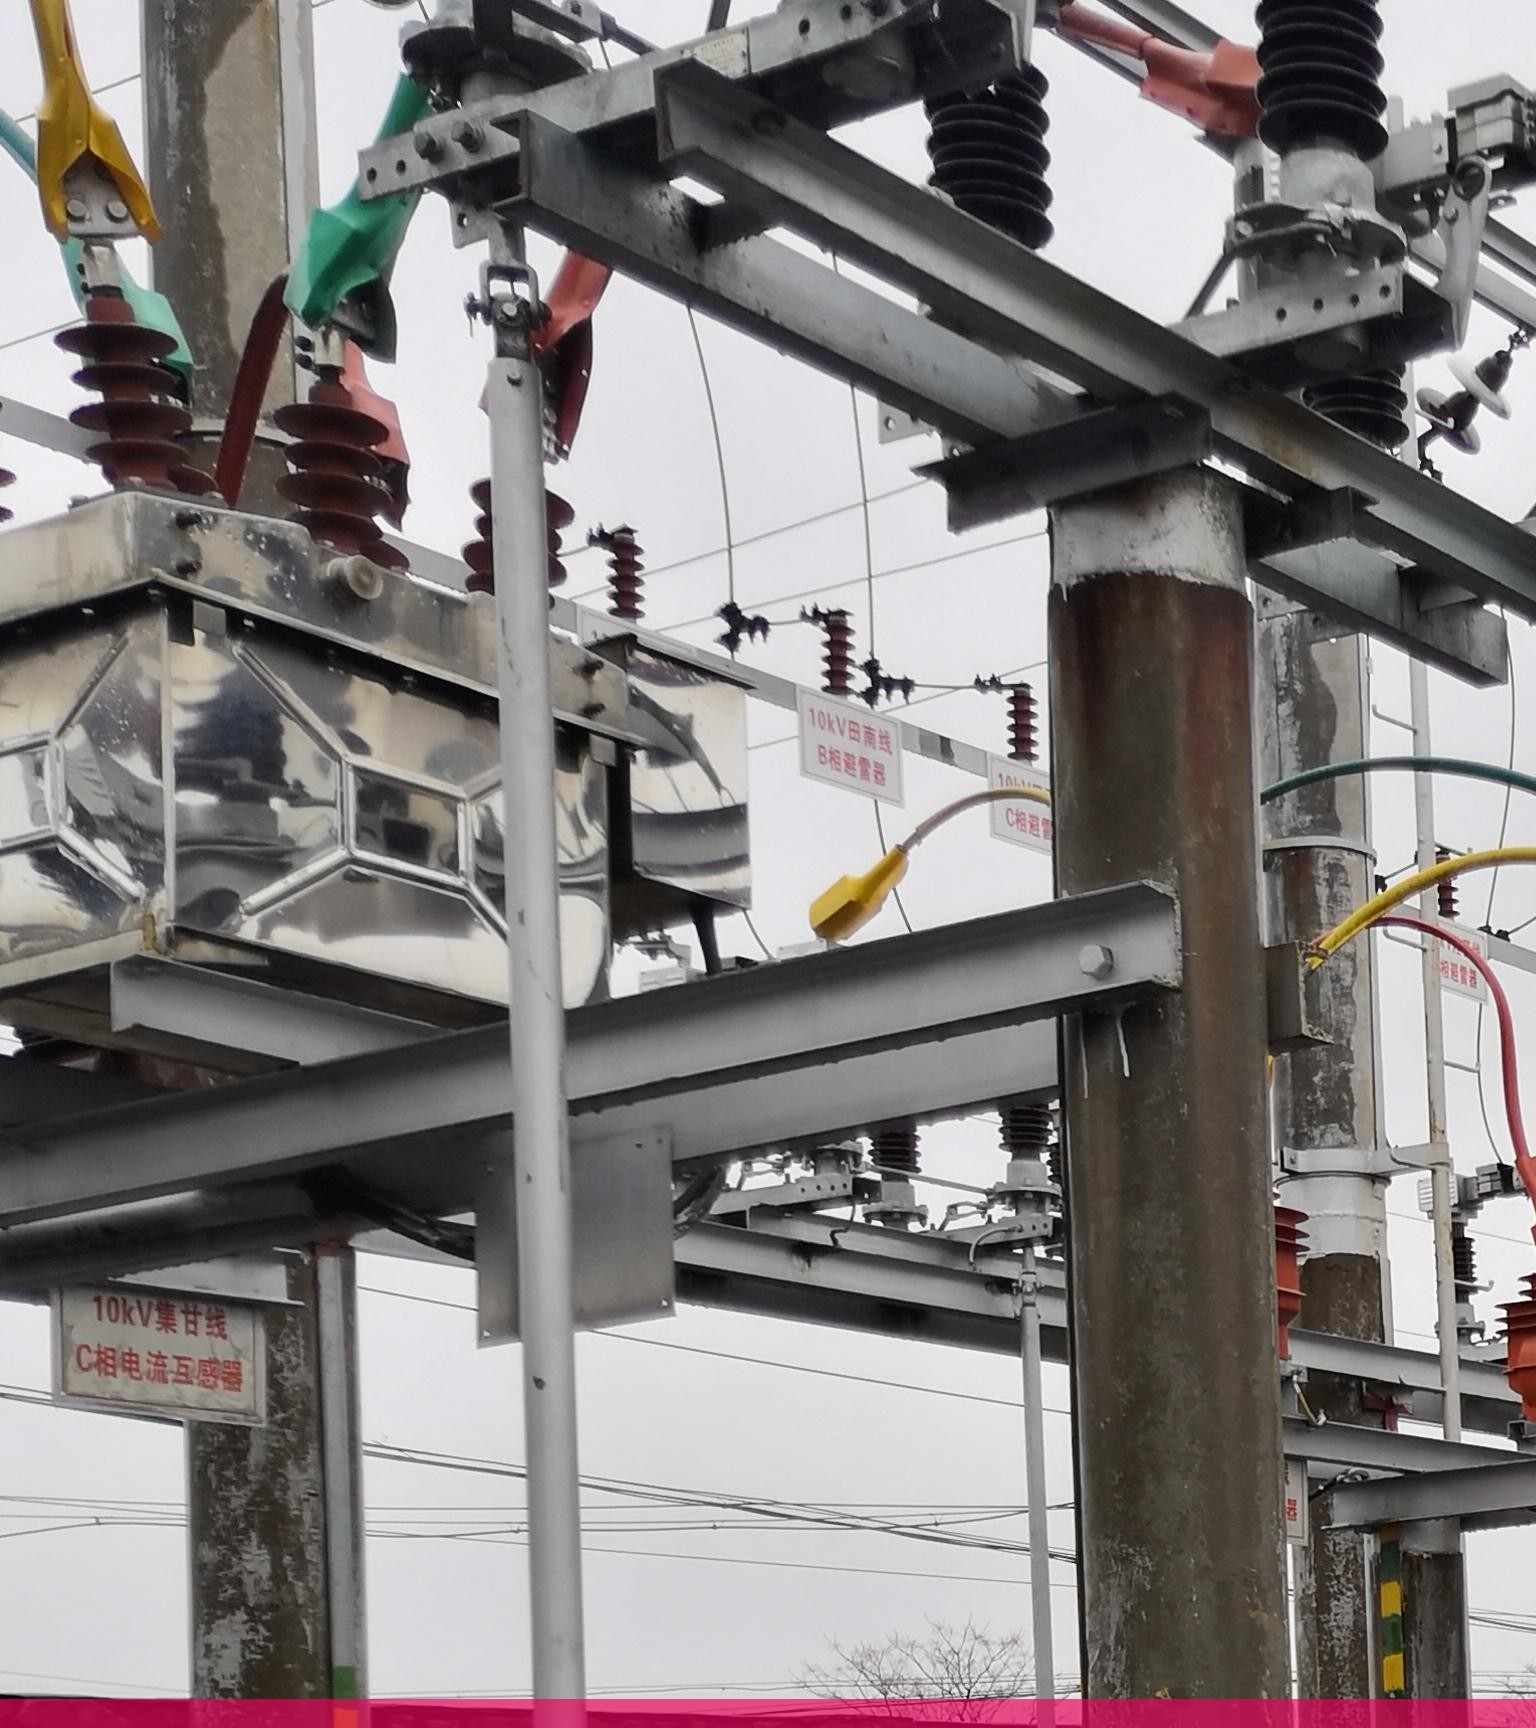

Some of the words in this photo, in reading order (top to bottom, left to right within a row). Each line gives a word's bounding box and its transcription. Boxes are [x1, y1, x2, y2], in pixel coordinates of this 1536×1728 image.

[809, 708, 893, 756] 10kV田南线
[818, 745, 886, 787] B相避雷器
[93, 1296, 227, 1341] 10kV集甘线
[76, 1343, 243, 1393] C相电流互感器
